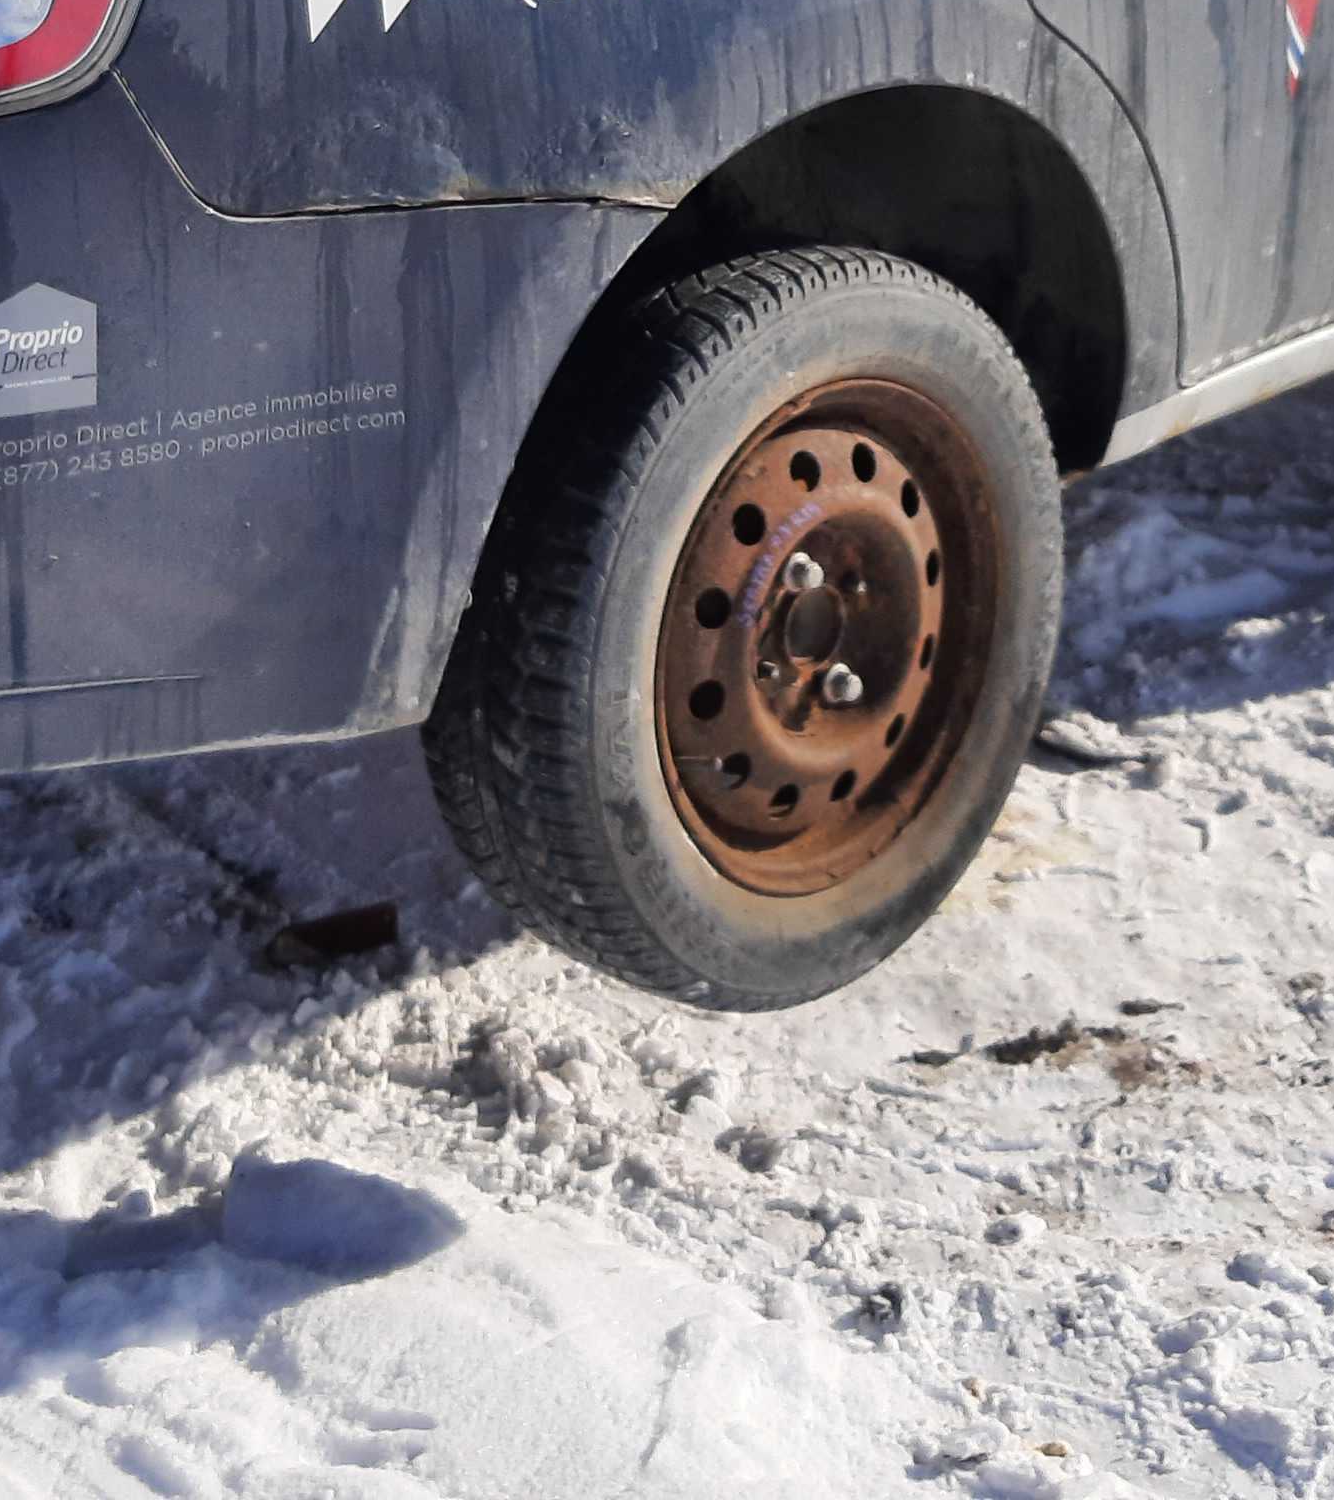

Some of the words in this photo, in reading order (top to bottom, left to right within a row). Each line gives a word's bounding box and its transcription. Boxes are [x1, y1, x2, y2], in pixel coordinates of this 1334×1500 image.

[1, 346, 69, 375] Direct
[76, 415, 148, 445] Direct
[170, 401, 258, 431] Agence
[265, 381, 398, 414] immobilière
[67, 449, 113, 478] 243
[120, 438, 181, 469] 8580
